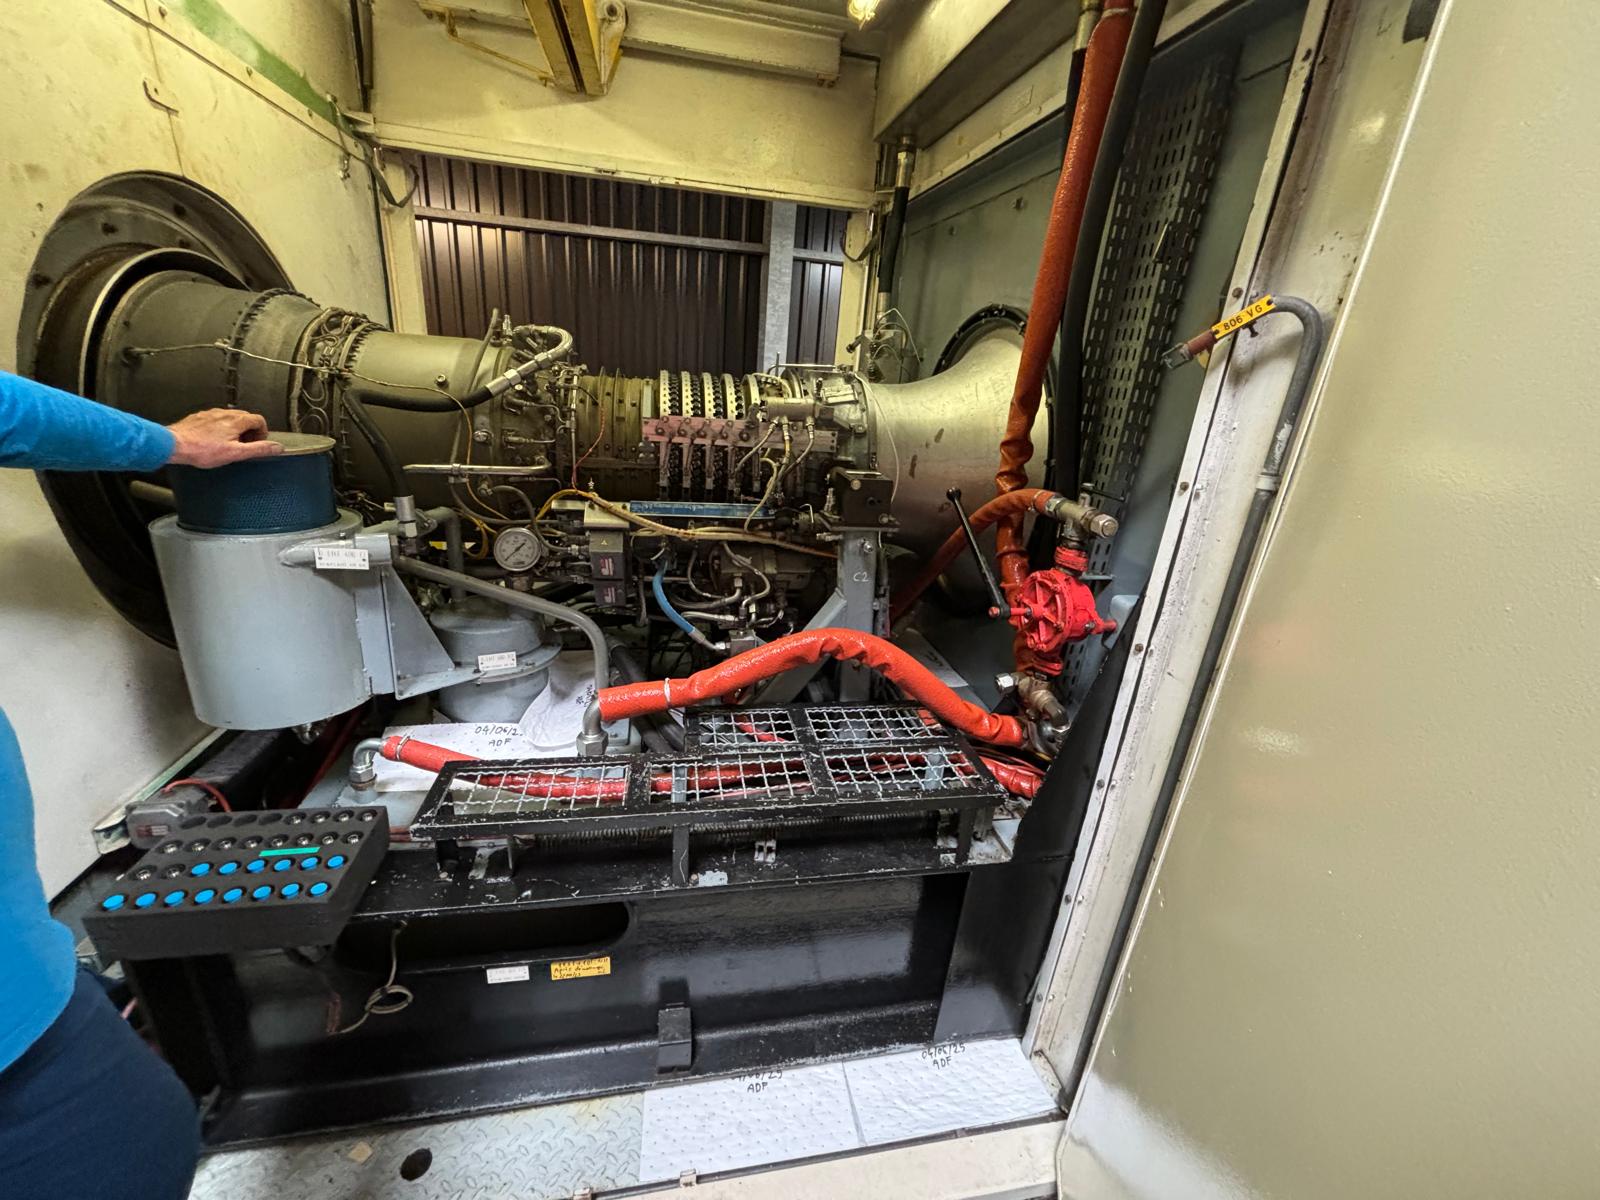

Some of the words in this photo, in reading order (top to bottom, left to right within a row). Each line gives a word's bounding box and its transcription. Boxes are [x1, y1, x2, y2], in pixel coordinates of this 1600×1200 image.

[1223, 315, 1243, 330] 806
[853, 571, 869, 582] C2
[474, 725, 524, 737] 04/06/2
[932, 1055, 952, 1070] ADF
